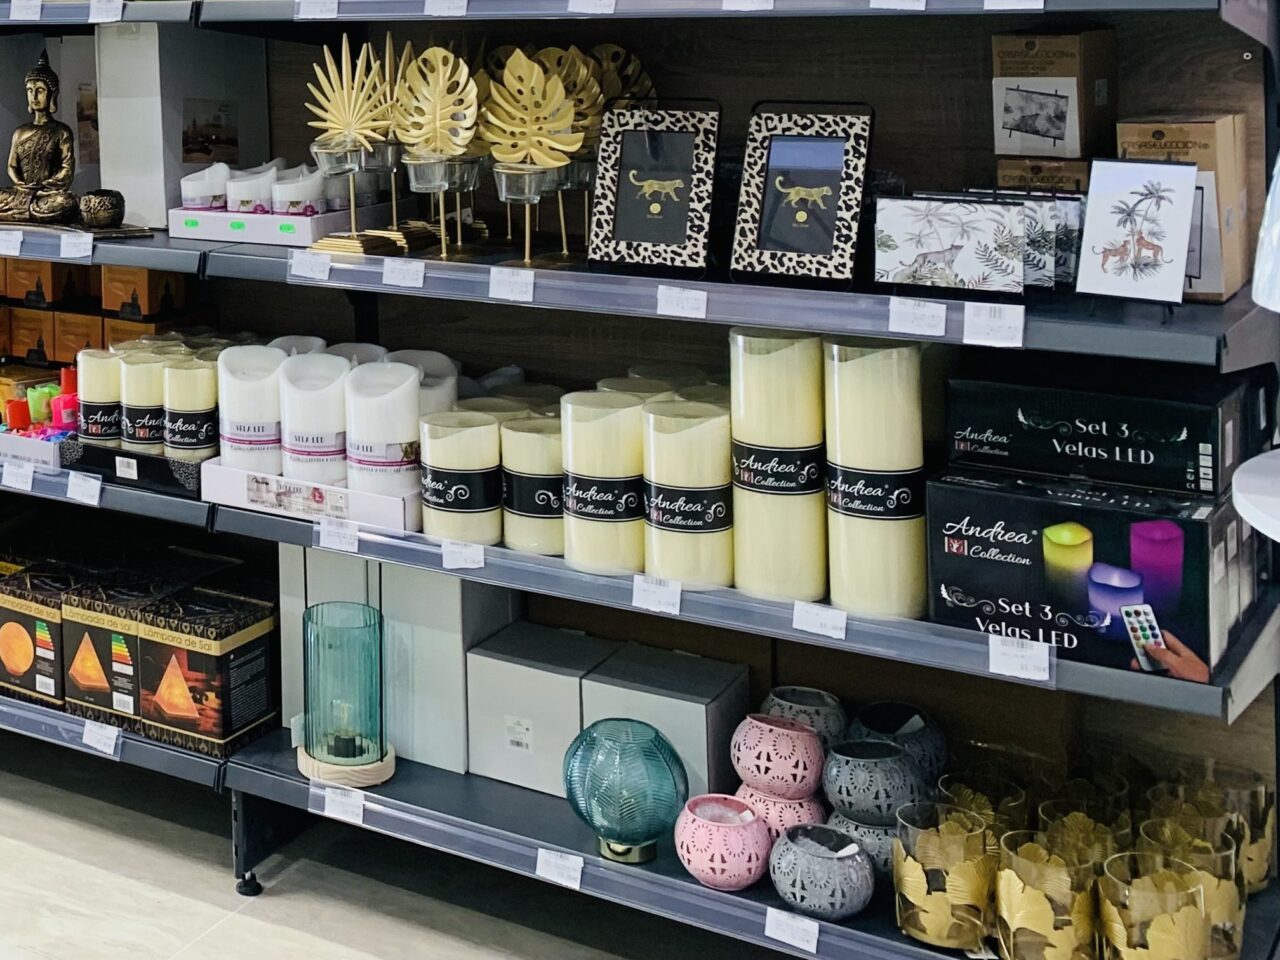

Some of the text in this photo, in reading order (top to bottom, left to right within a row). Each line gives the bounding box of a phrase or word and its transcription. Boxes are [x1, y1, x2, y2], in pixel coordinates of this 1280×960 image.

[954, 427, 1010, 444] Andrea
[1075, 418, 1129, 438] Set 3
[971, 444, 1010, 456] Collection
[1052, 438, 1155, 465] Velas LED
[740, 455, 798, 474] Andrea
[754, 477, 797, 488] Collection
[830, 476, 886, 497] Andrea
[565, 483, 616, 502] Andrea
[577, 504, 615, 515] Collection
[649, 493, 704, 512] Andrea
[841, 498, 885, 512] Collection
[662, 516, 703, 526] Collection
[942, 516, 1033, 545] Andrea
[969, 545, 1032, 565] Collection
[998, 598, 1053, 620] Set 3
[975, 617, 1078, 649] Velas LED
[184, 637, 197, 648] de
[198, 640, 213, 651] Sal
